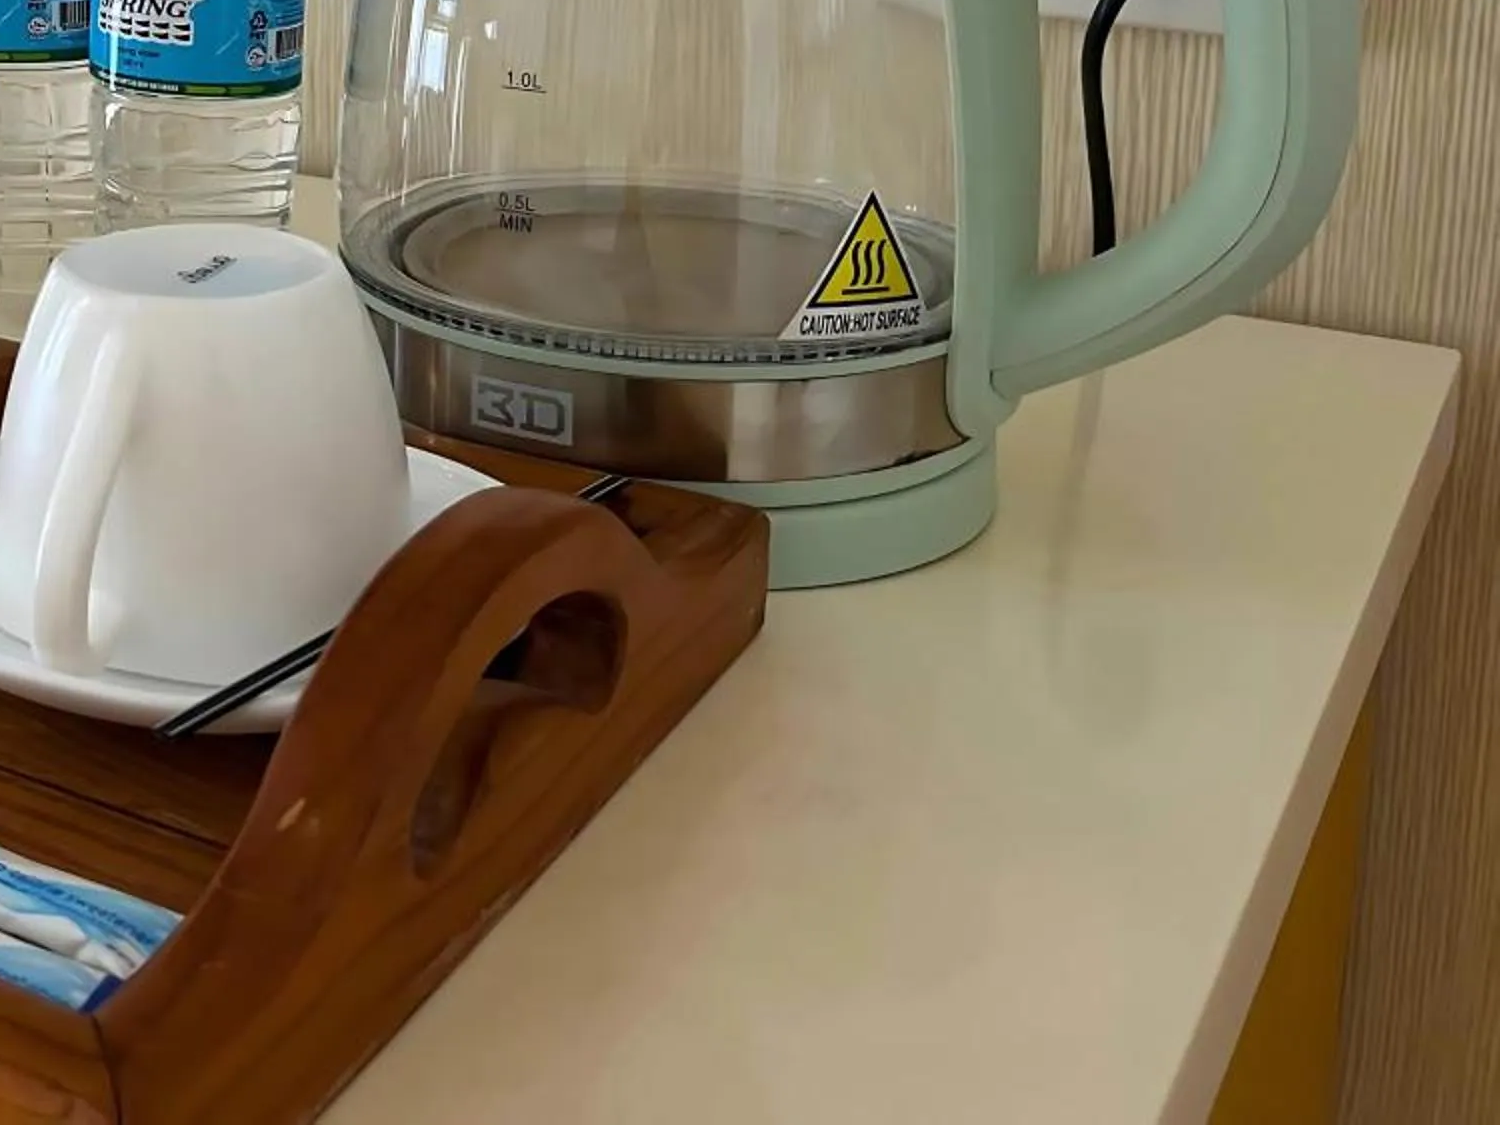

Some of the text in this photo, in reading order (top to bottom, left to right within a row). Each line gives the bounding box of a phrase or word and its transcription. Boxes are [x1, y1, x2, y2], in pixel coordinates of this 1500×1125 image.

[507, 72, 542, 90] 1.0L
[498, 192, 536, 212] 0.5L
[499, 213, 534, 234] MIN
[877, 305, 922, 330] SURFACE
[476, 379, 566, 437] 3D
